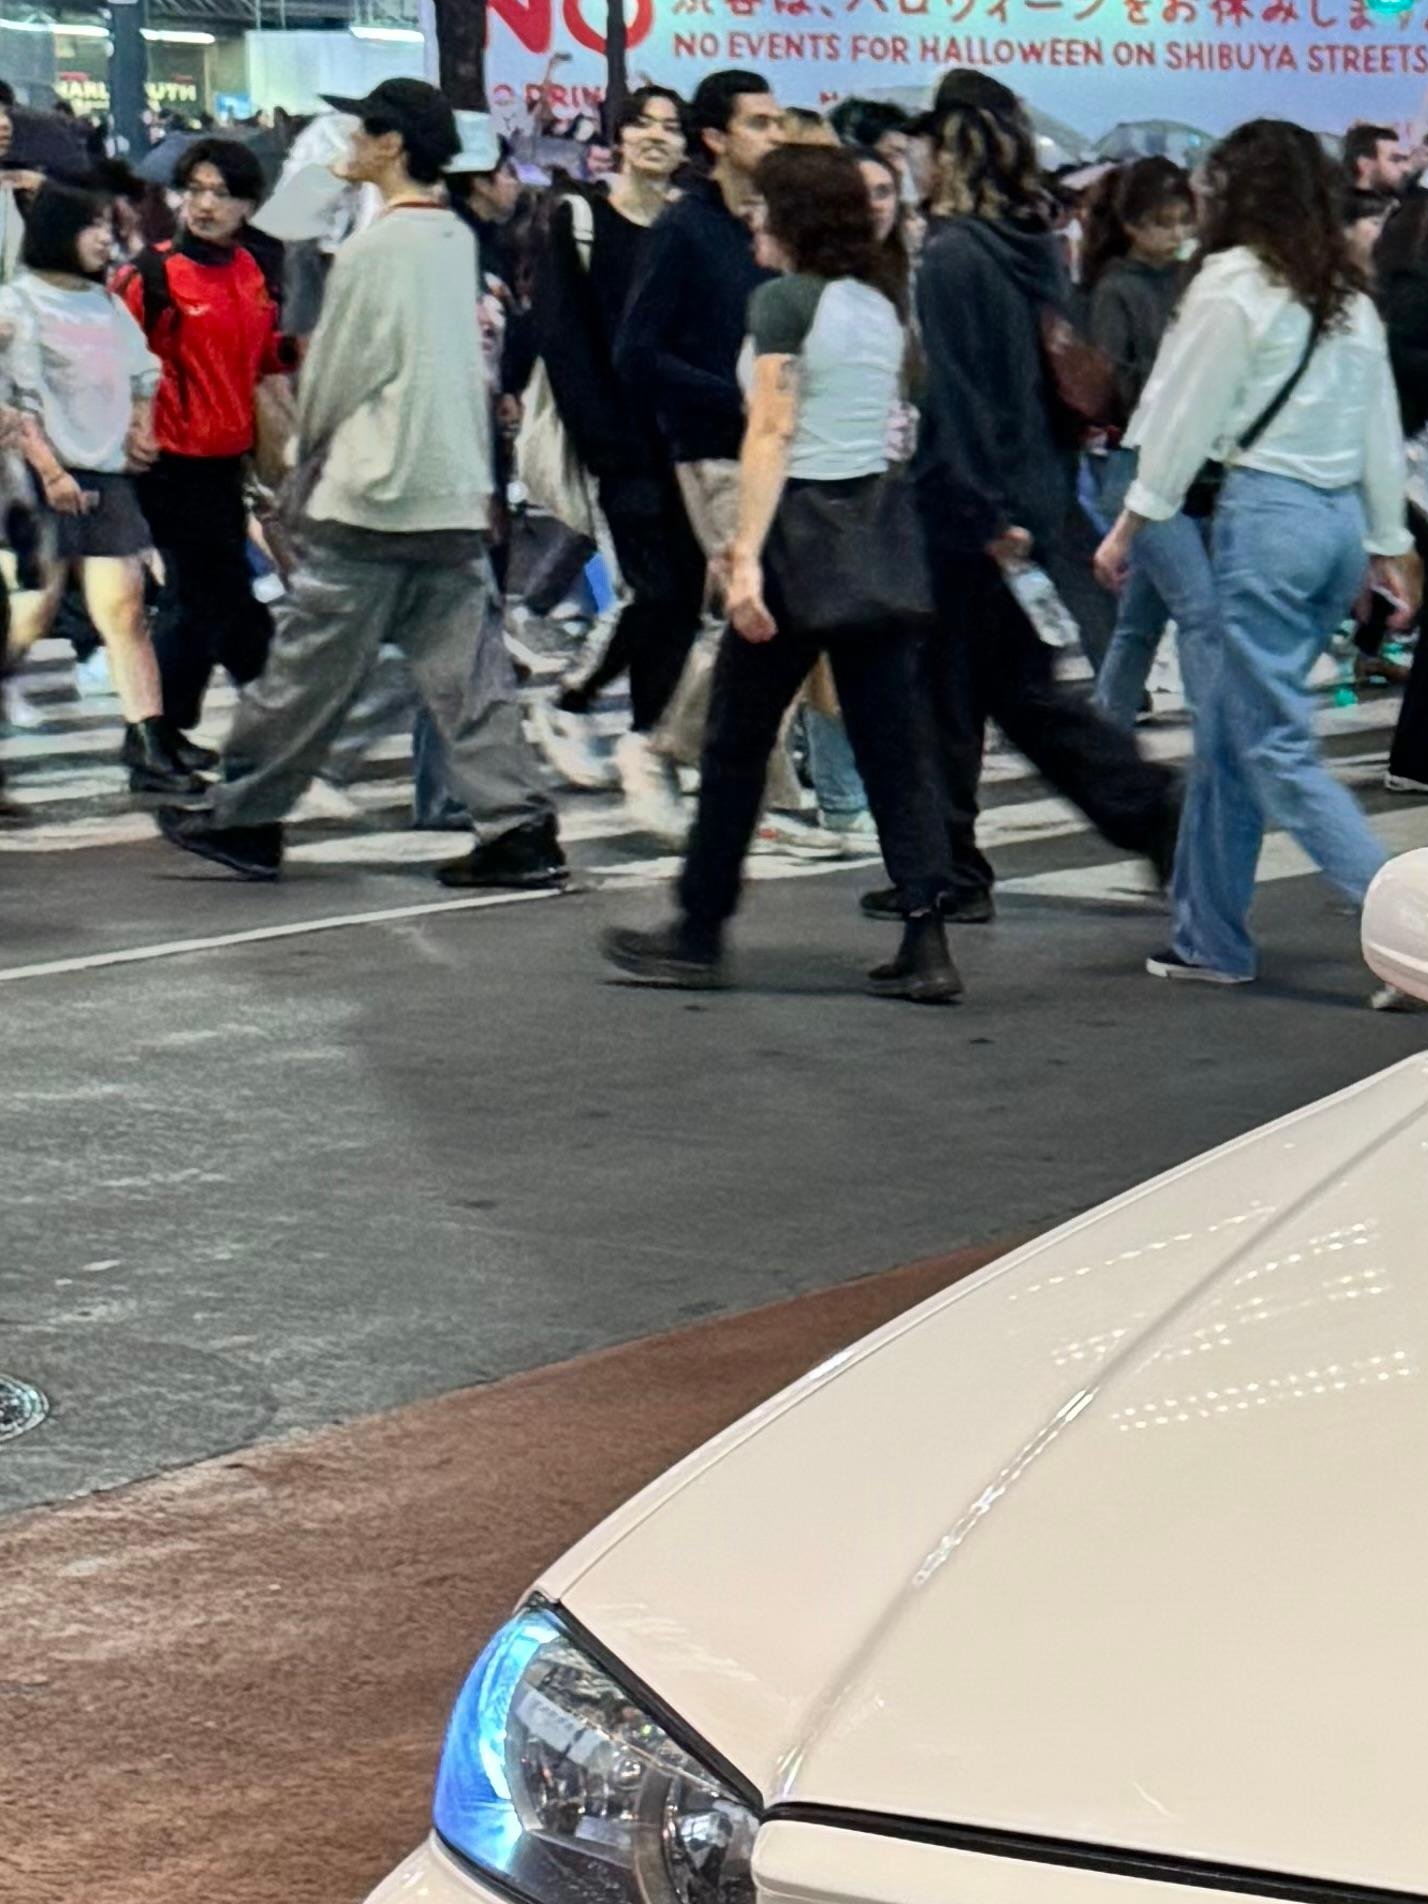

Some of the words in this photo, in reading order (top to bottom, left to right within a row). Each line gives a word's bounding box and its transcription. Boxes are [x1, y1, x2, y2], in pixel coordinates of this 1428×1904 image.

[673, 32, 719, 58] NO
[729, 32, 840, 61] EVENTS
[851, 34, 910, 64] FOR
[920, 35, 1102, 67] HALLOWEEN
[1113, 41, 1156, 68] ON
[1165, 41, 1298, 71] SHIBUYA
